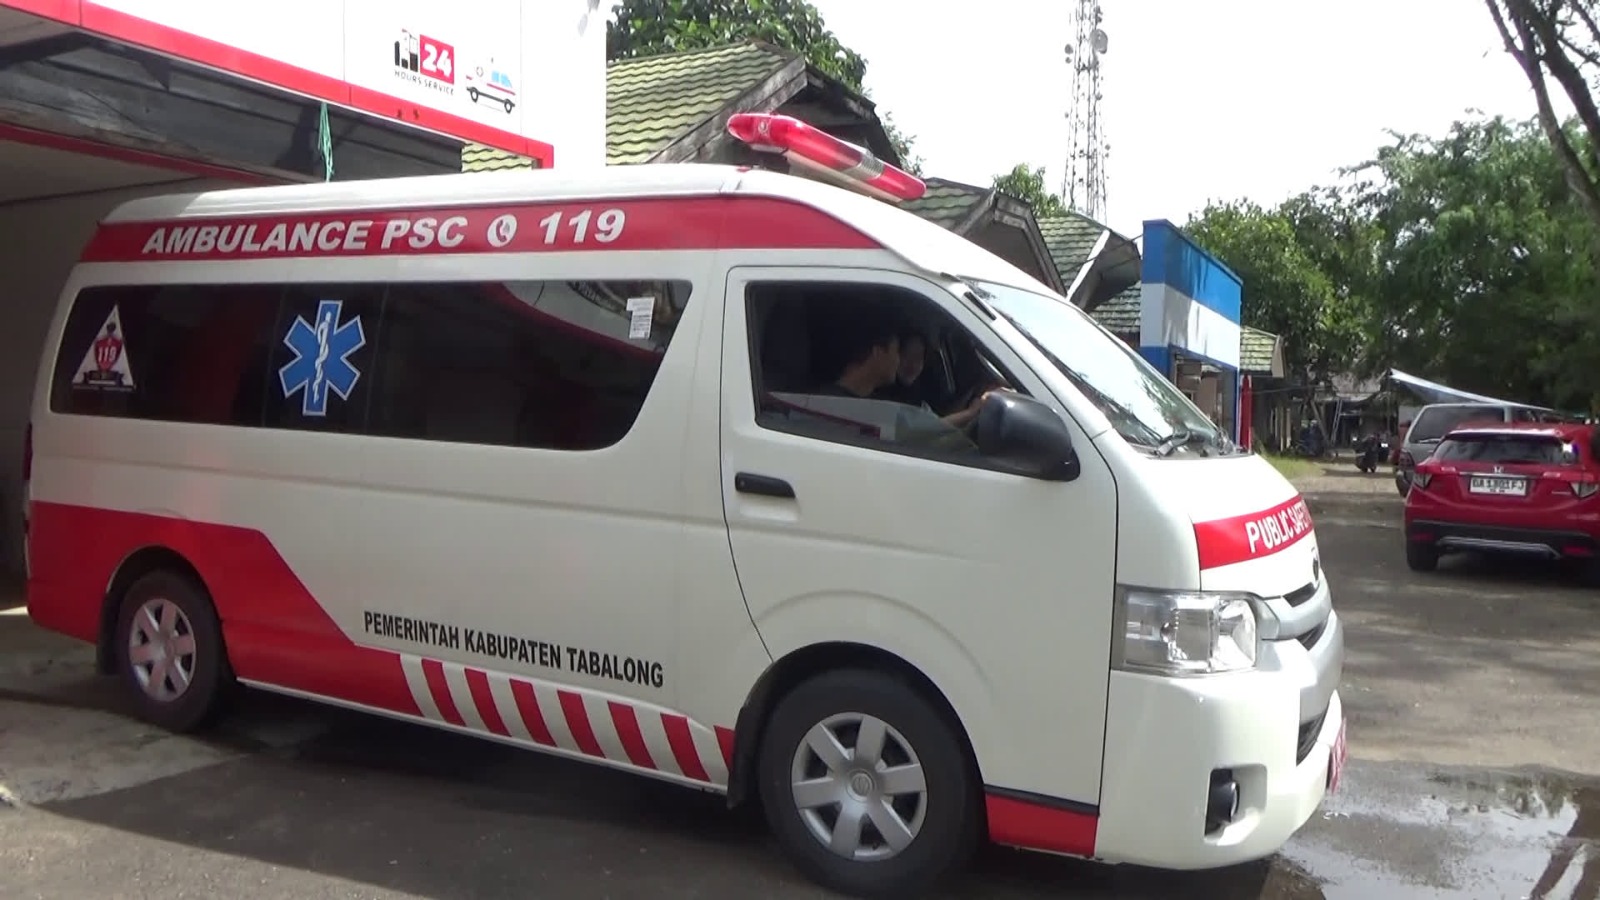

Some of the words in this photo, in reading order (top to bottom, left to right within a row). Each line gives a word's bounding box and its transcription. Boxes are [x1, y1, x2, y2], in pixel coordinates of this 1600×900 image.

[422, 42, 452, 77] 24
[394, 69, 422, 85] HOURS
[424, 79, 454, 96] SERVICE
[142, 220, 373, 254] AMBULANCE
[381, 216, 468, 249] PSC
[539, 209, 626, 244] 119
[98, 346, 117, 362] 119
[1245, 510, 1294, 554] PUBLIC
[364, 611, 459, 649] PEMERINTAH
[464, 628, 561, 669] KABUPATEN
[566, 646, 663, 689] TABALONG
